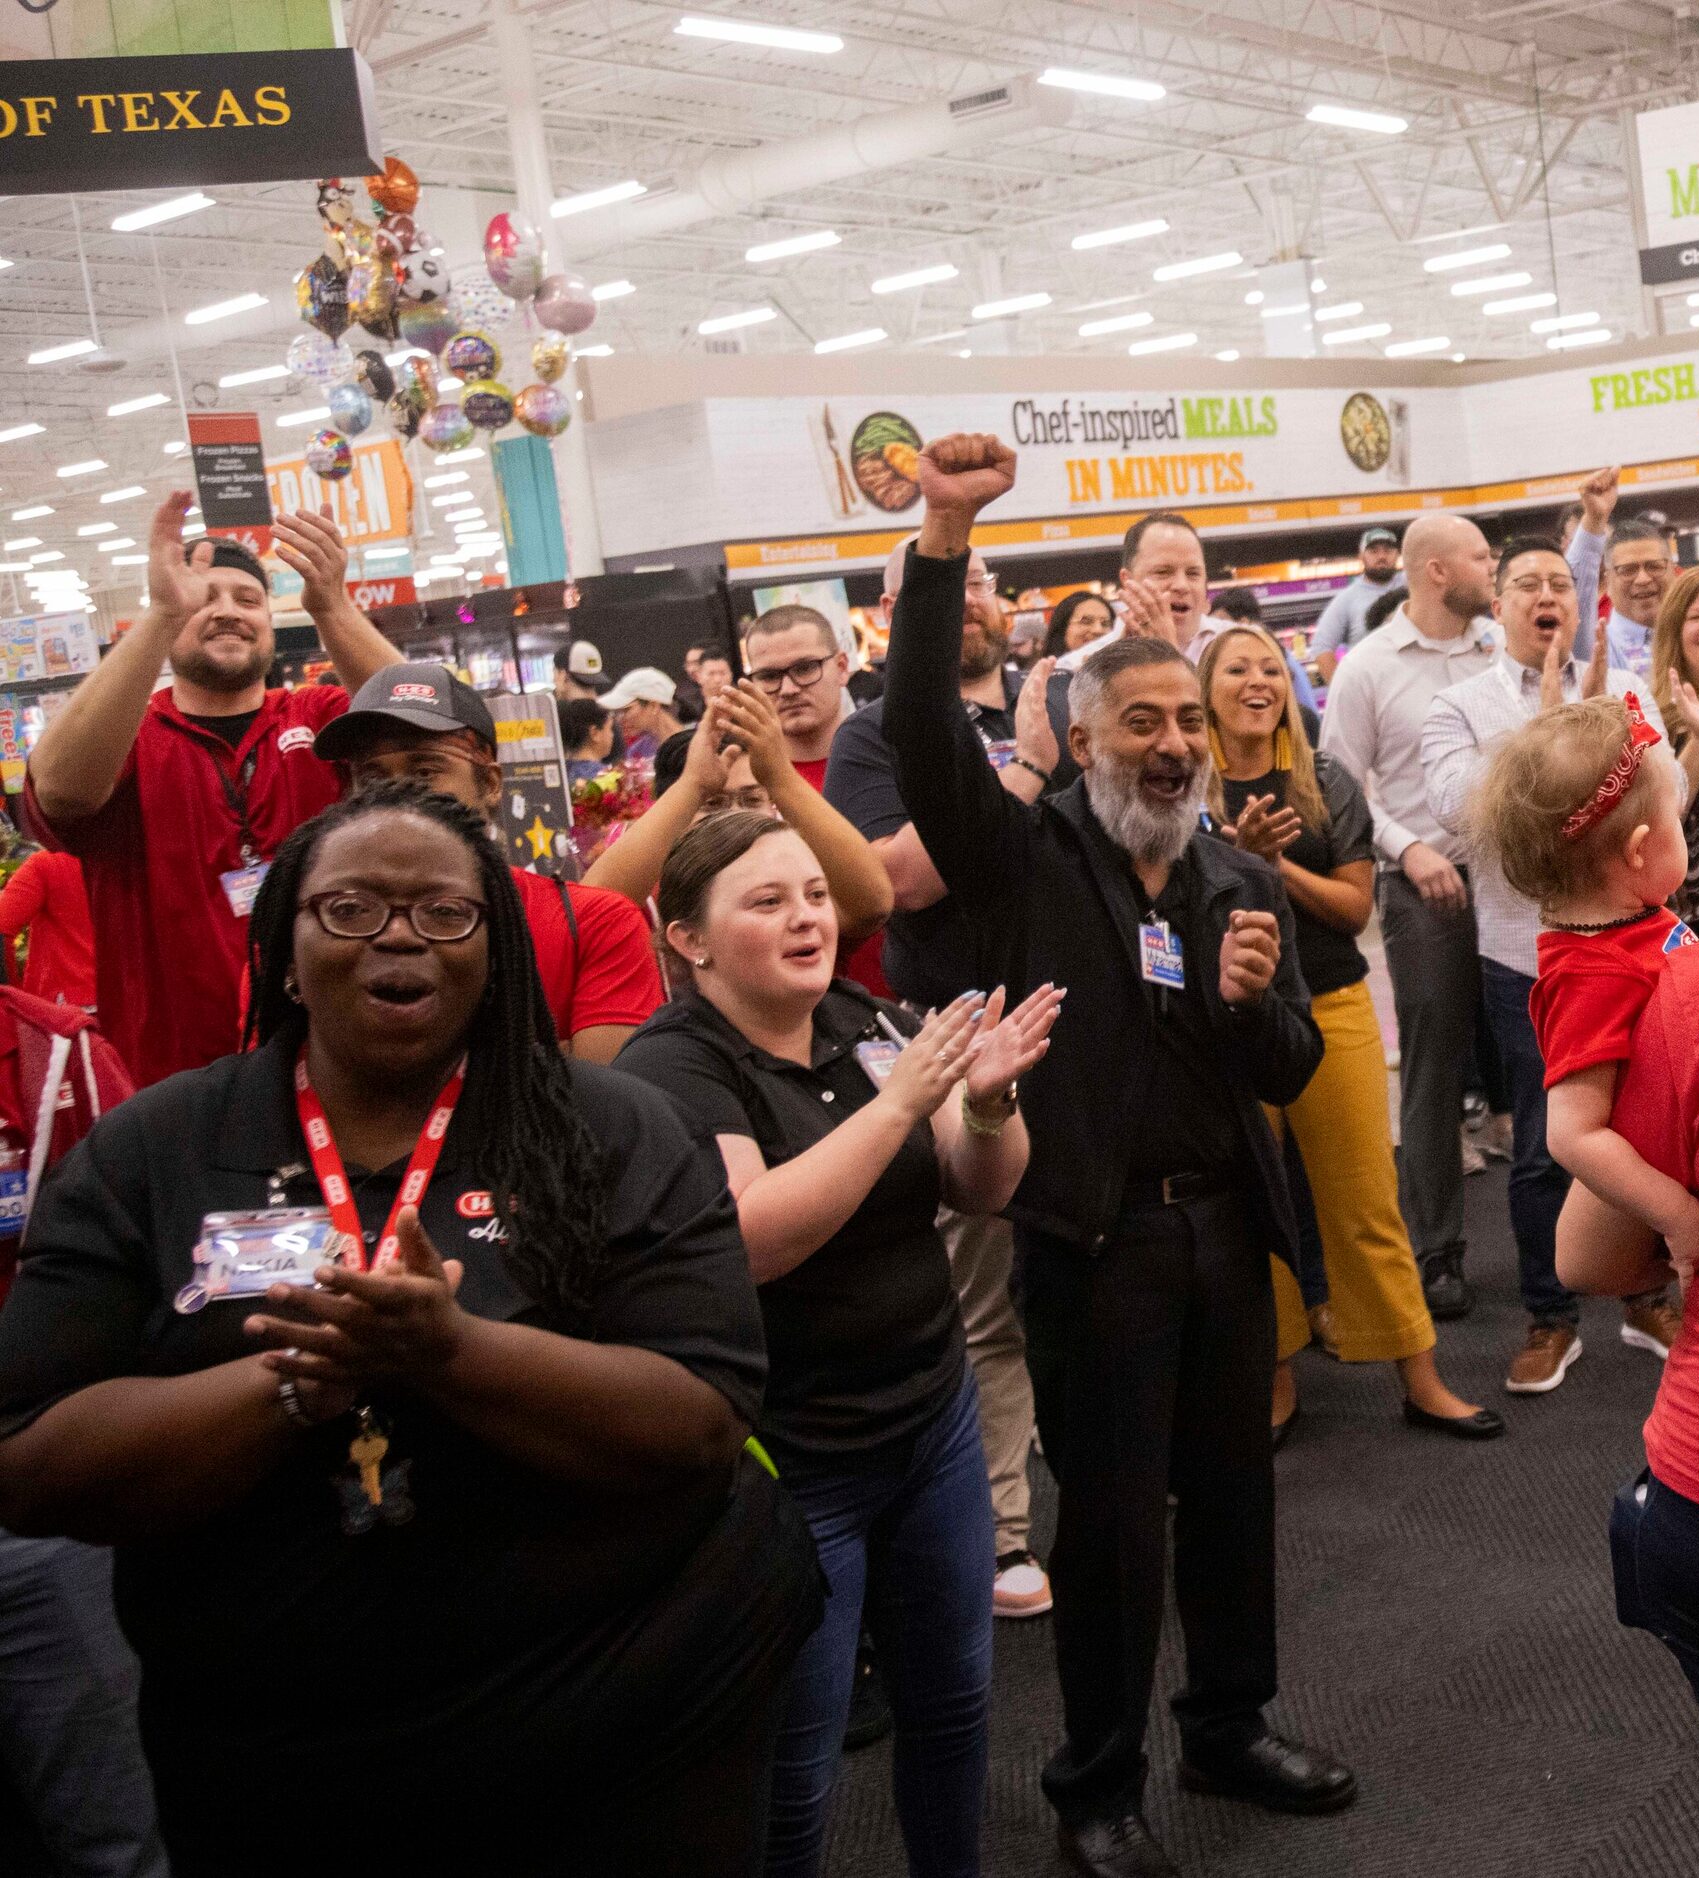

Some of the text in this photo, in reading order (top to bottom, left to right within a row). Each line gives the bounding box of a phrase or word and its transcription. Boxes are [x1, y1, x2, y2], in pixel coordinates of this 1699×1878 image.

[78, 86, 292, 135] TEXAS
[1013, 396, 1278, 450] Chef-inspired MEALS
[1066, 452, 1255, 503] IN MINUTES.
